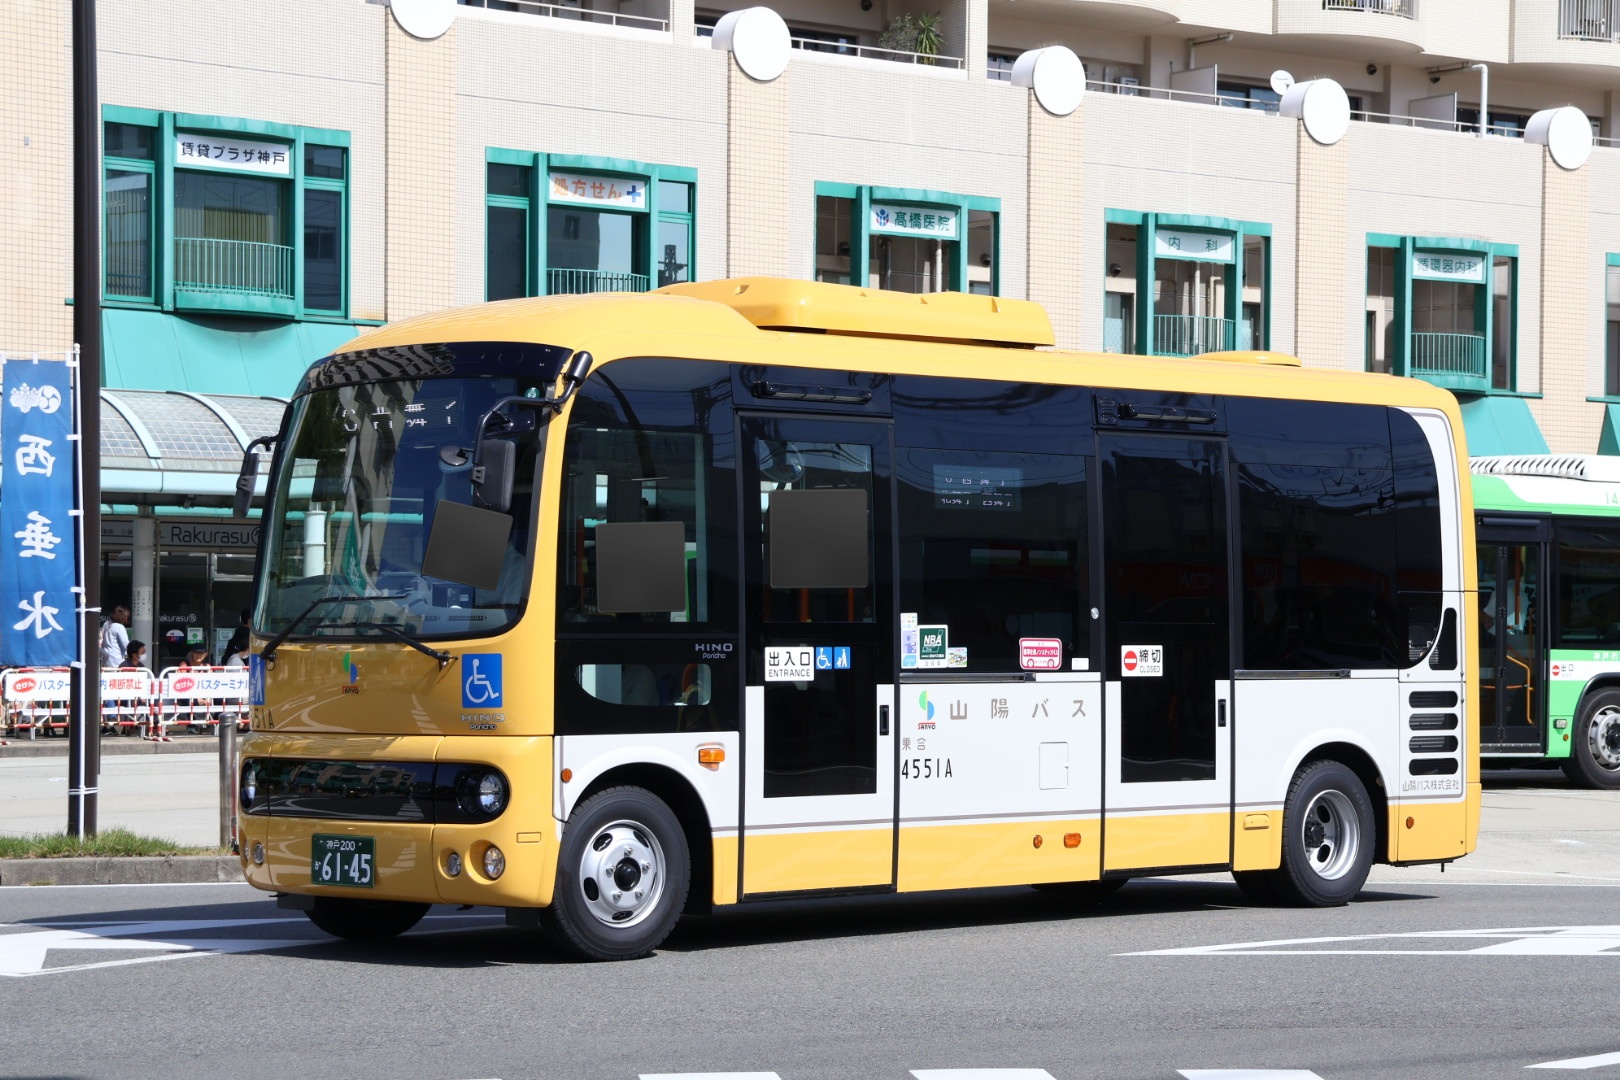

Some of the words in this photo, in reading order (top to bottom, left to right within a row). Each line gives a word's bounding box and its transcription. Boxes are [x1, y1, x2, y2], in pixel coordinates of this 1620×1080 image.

[181, 141, 285, 165] 賃貸プラザ神戸
[553, 177, 622, 201] 処方せん
[1417, 258, 1477, 274] 循環器内科
[171, 526, 250, 545] Rakurasu
[159, 613, 189, 622] akurasu
[923, 635, 942, 645] NBA
[695, 643, 733, 652] HINO
[768, 651, 811, 667] 出入口
[1139, 649, 1161, 663] 締切
[768, 669, 811, 677] ENTRANCE
[1140, 665, 1161, 673] CLOSED
[950, 698, 1086, 720] 山陽バス
[461, 713, 505, 722] HINO
[902, 737, 926, 751] 乗合
[901, 758, 953, 779] 4551A
[1402, 780, 1459, 792] 山陽バス株式会社
